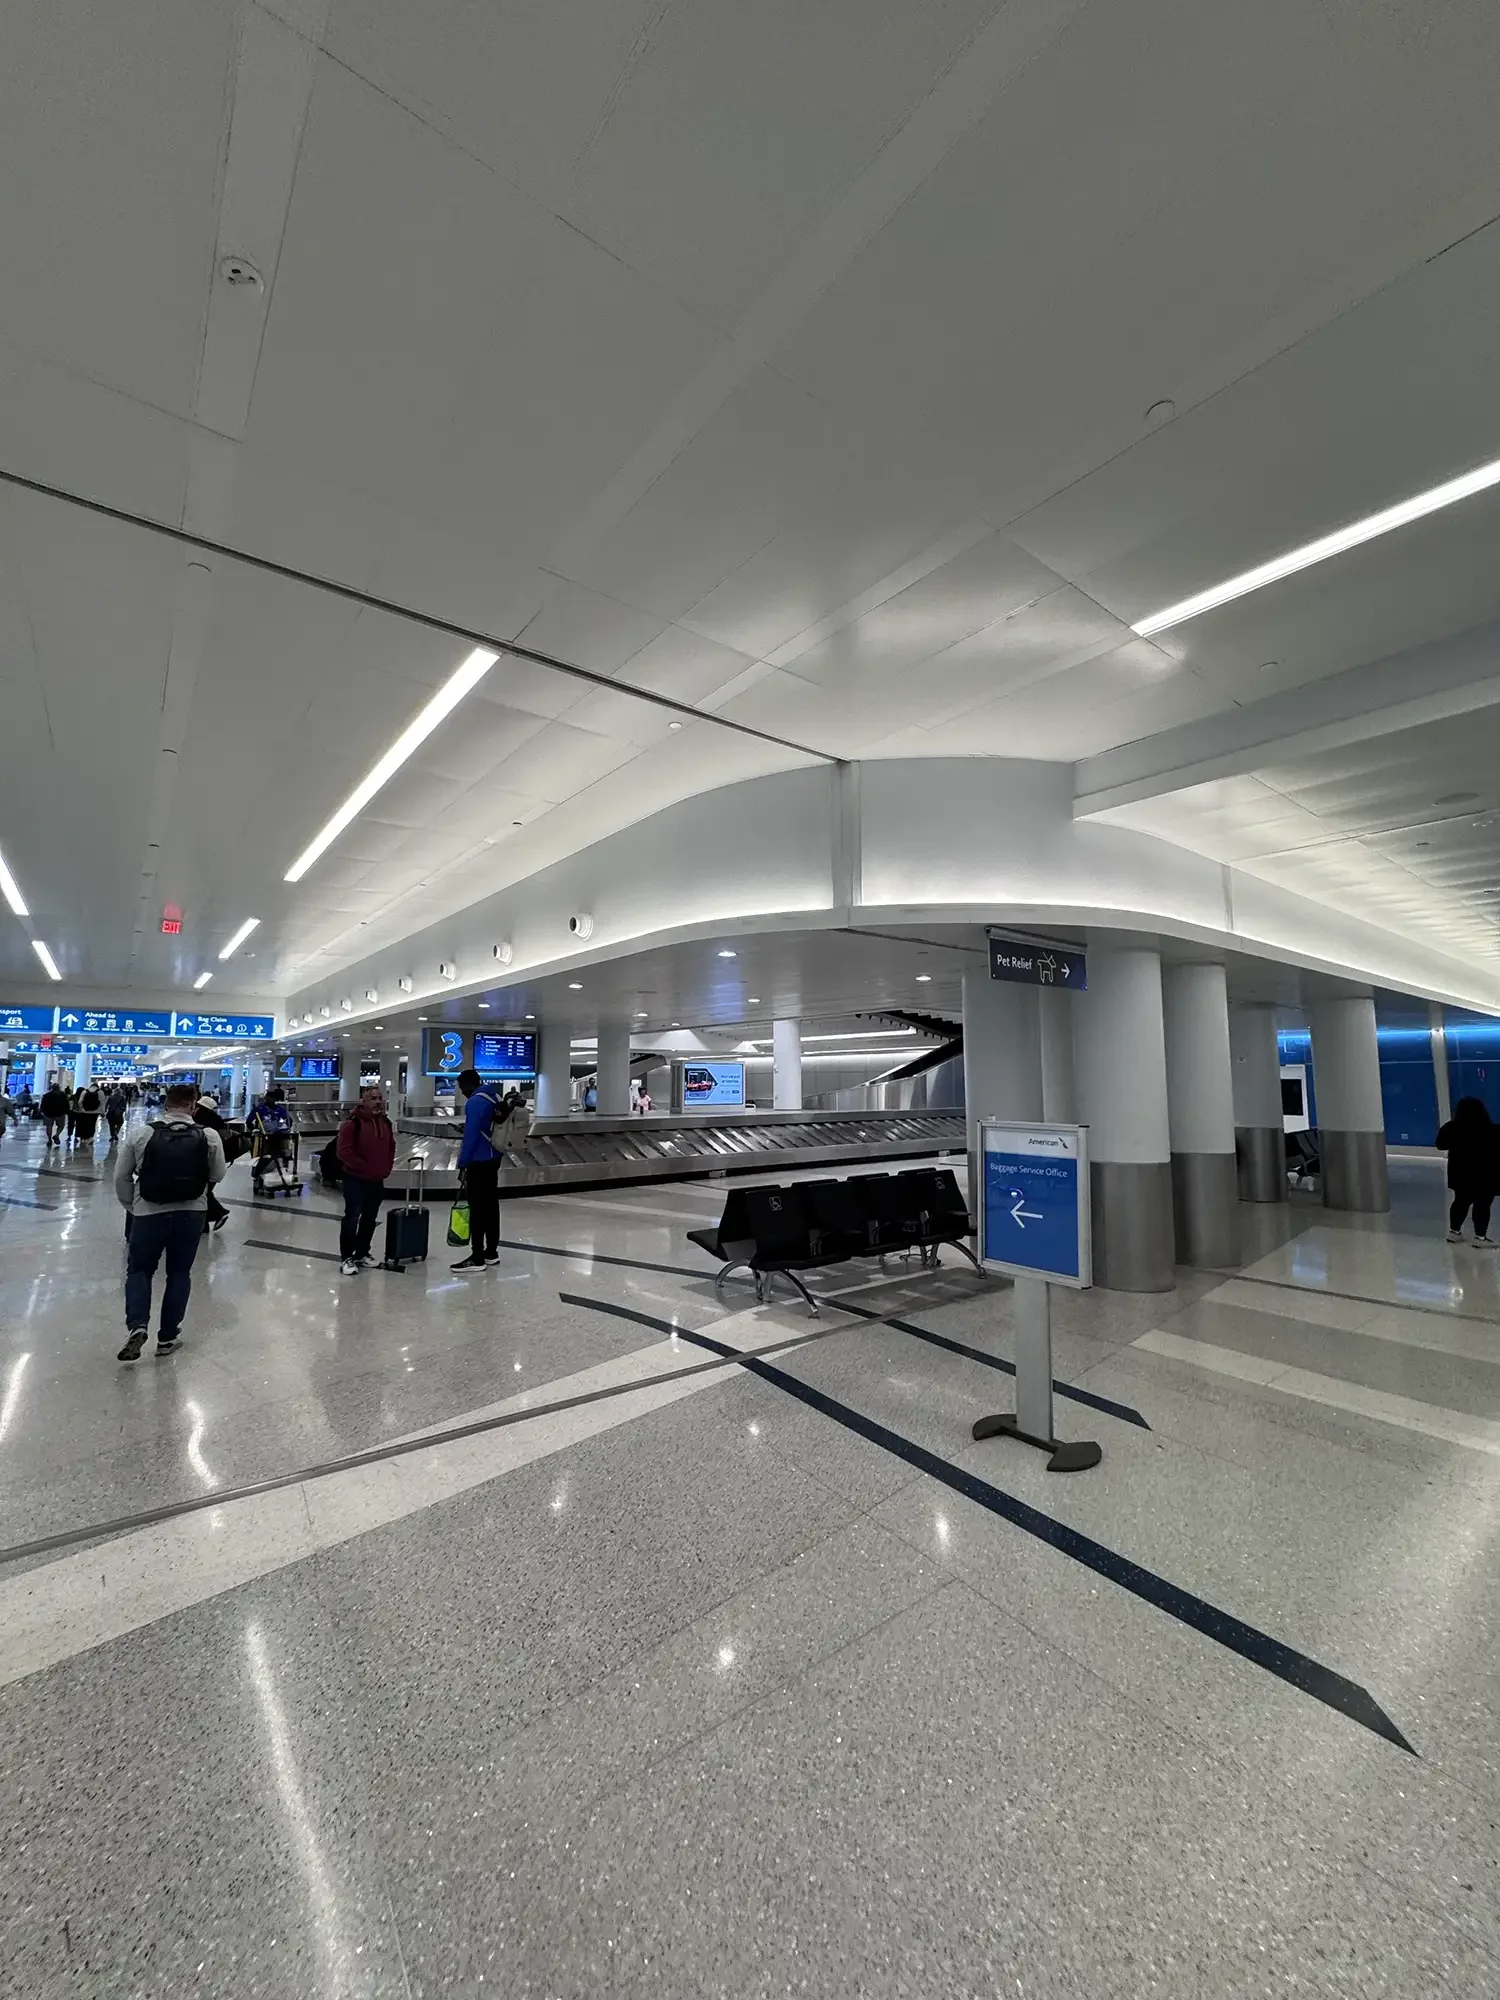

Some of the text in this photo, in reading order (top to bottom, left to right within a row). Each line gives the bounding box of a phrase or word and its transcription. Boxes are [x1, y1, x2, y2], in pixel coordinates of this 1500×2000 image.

[997, 954, 1033, 970] Pet Relief
[214, 1024, 233, 1033] 4-8
[439, 1031, 463, 1069] 3
[279, 1056, 296, 1077] 4
[1028, 1138, 1059, 1147] American
[990, 1162, 1068, 1178] Baggage Service Office
